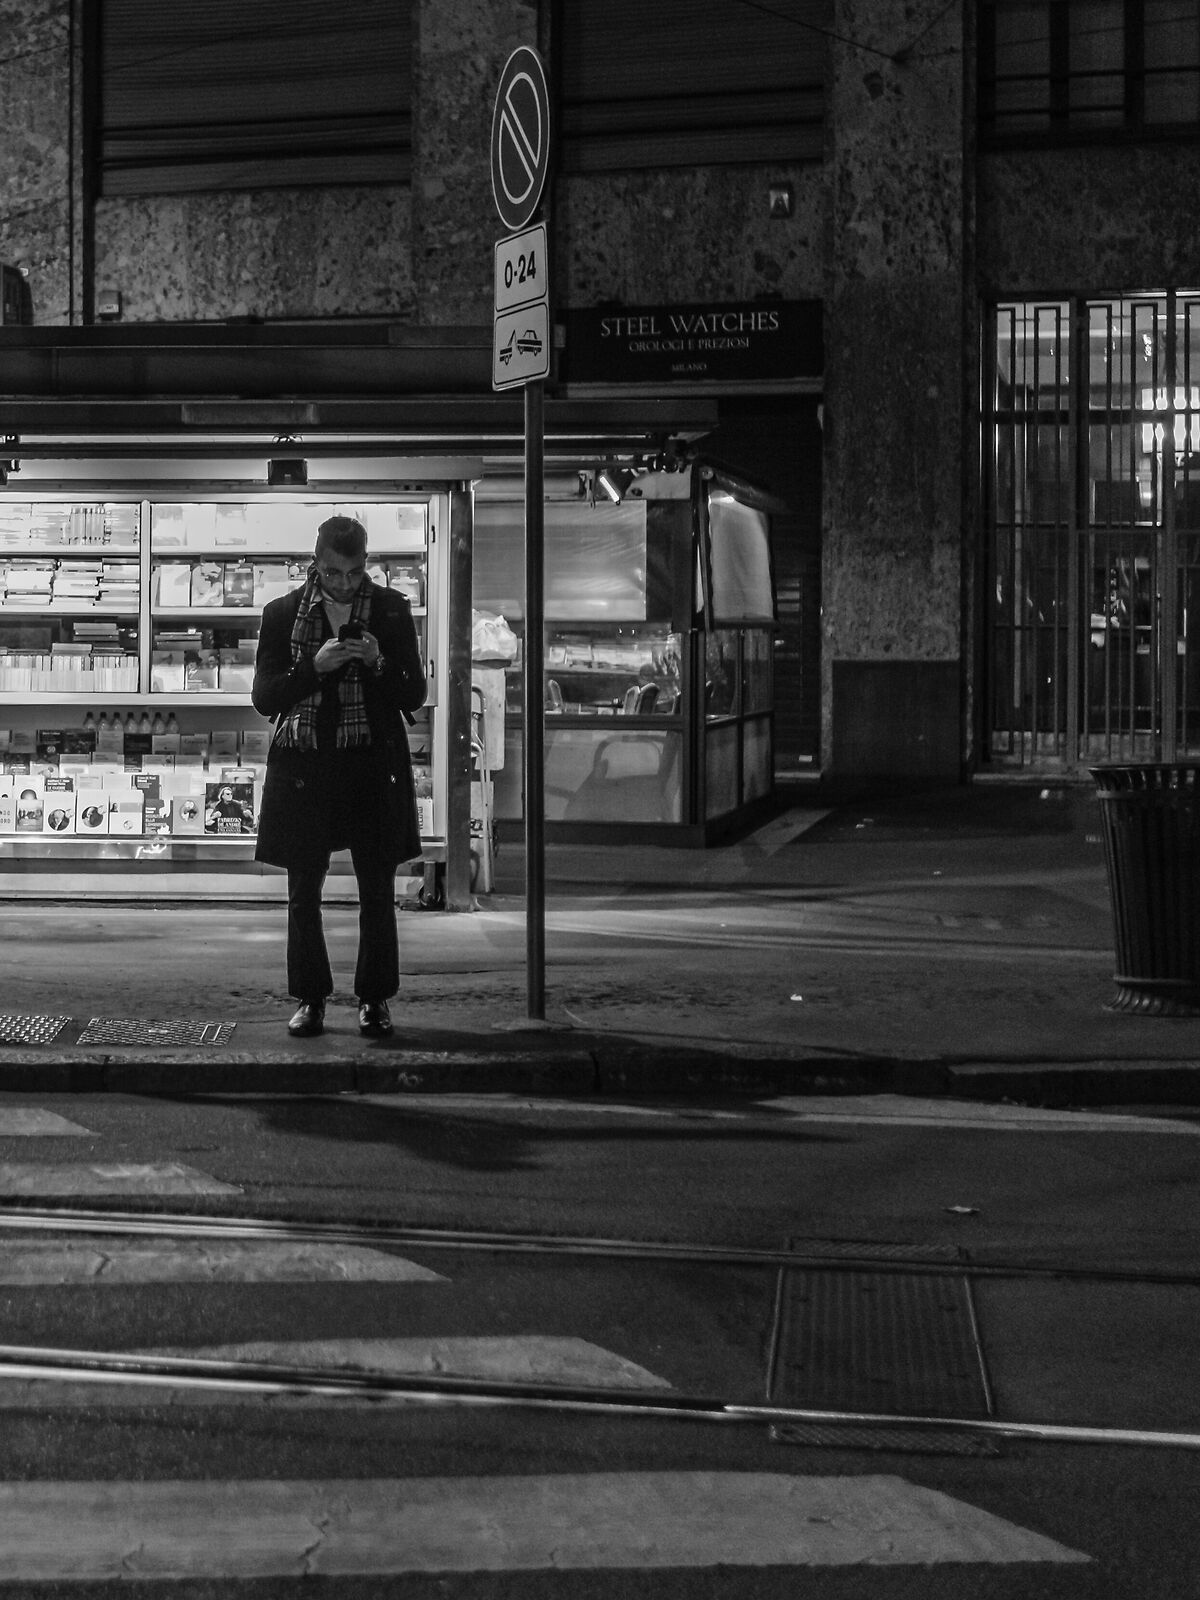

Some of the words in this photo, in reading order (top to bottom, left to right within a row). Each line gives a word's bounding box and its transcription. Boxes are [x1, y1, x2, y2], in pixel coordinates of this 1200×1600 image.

[504, 250, 536, 288] 0-24
[600, 316, 661, 337] STEEL
[669, 311, 779, 333] WATCHES
[629, 339, 684, 352] OROLOGI
[698, 336, 750, 350] PREZIOSI
[671, 363, 707, 373] MILANO
